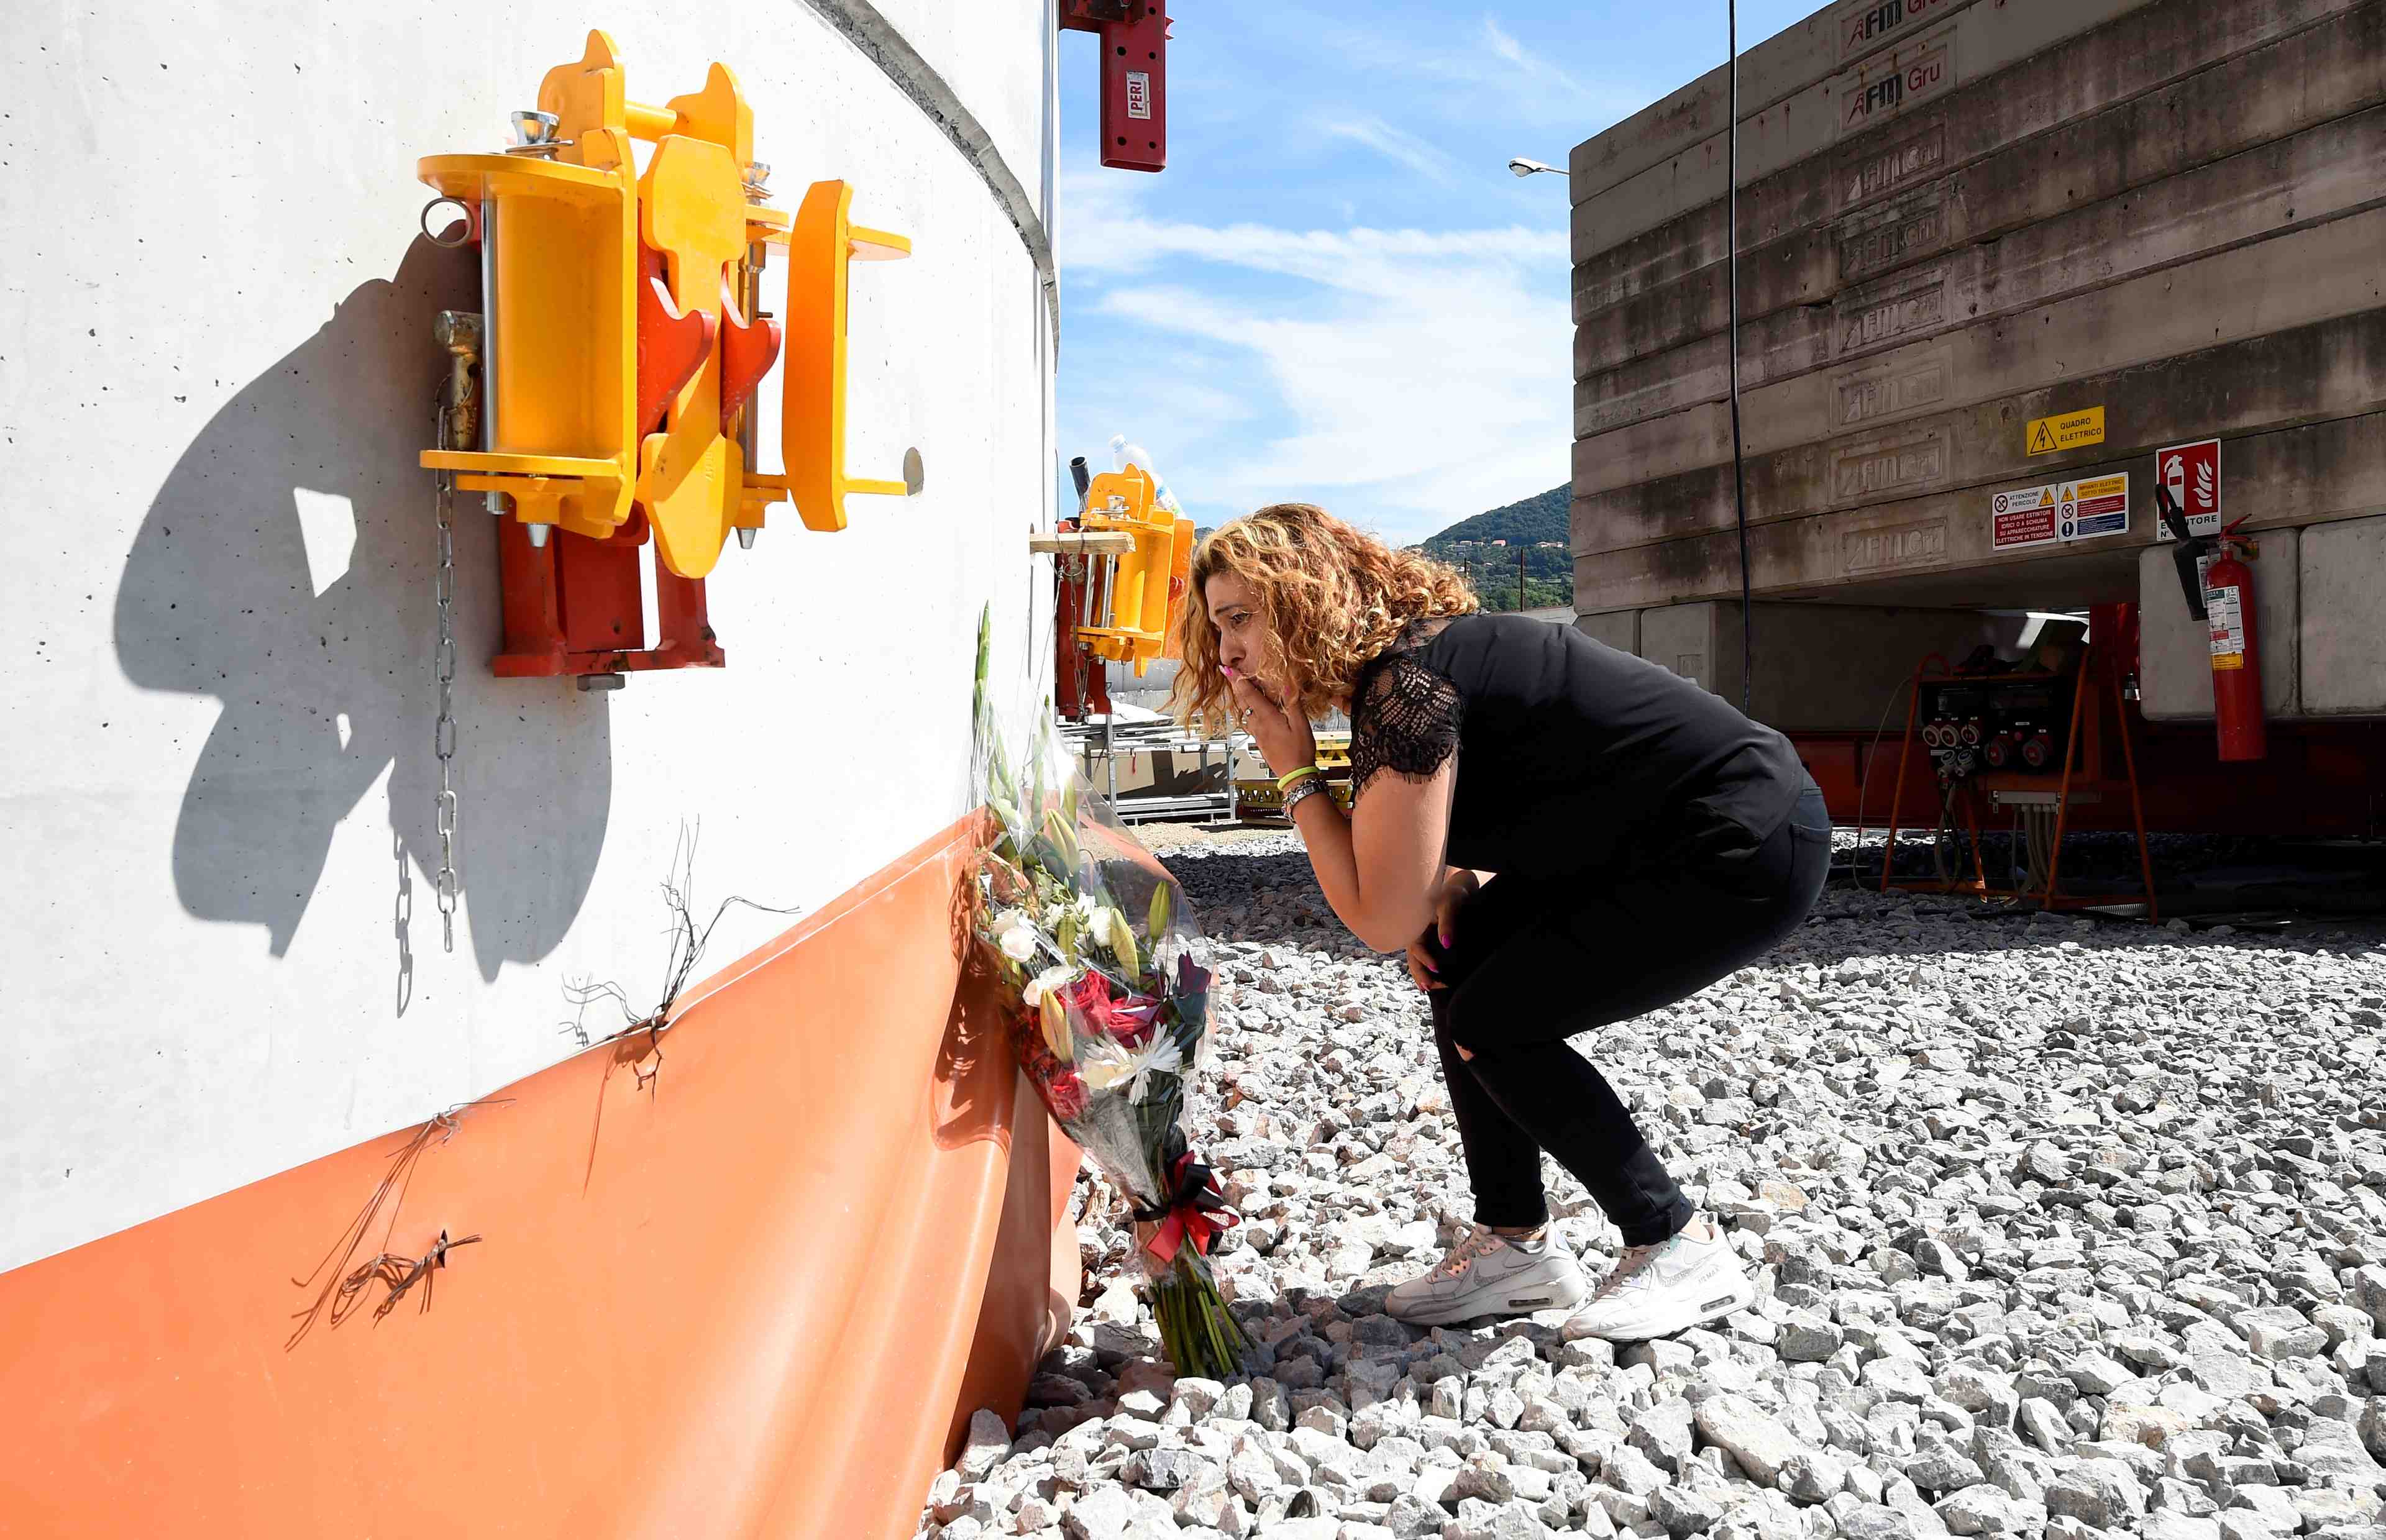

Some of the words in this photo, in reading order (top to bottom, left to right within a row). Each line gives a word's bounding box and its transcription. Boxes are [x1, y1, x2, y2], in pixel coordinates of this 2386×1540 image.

[1908, 63, 1940, 91] Gru
[1130, 81, 1143, 111] PERI
[2060, 417, 2091, 430] QUADRO
[2060, 427, 2101, 442] ELETTRICO
[2009, 491, 2039, 500] ATTENZIONE
[2013, 499, 2036, 507] PERICOLO
[2009, 513, 2025, 521] USARE
[2161, 515, 2218, 529] ETORE
[2007, 524, 2049, 535] APPARECCHIATURE
[1996, 535, 2023, 544] ELETTRICHE
[2030, 531, 2053, 539] TENSIONE
